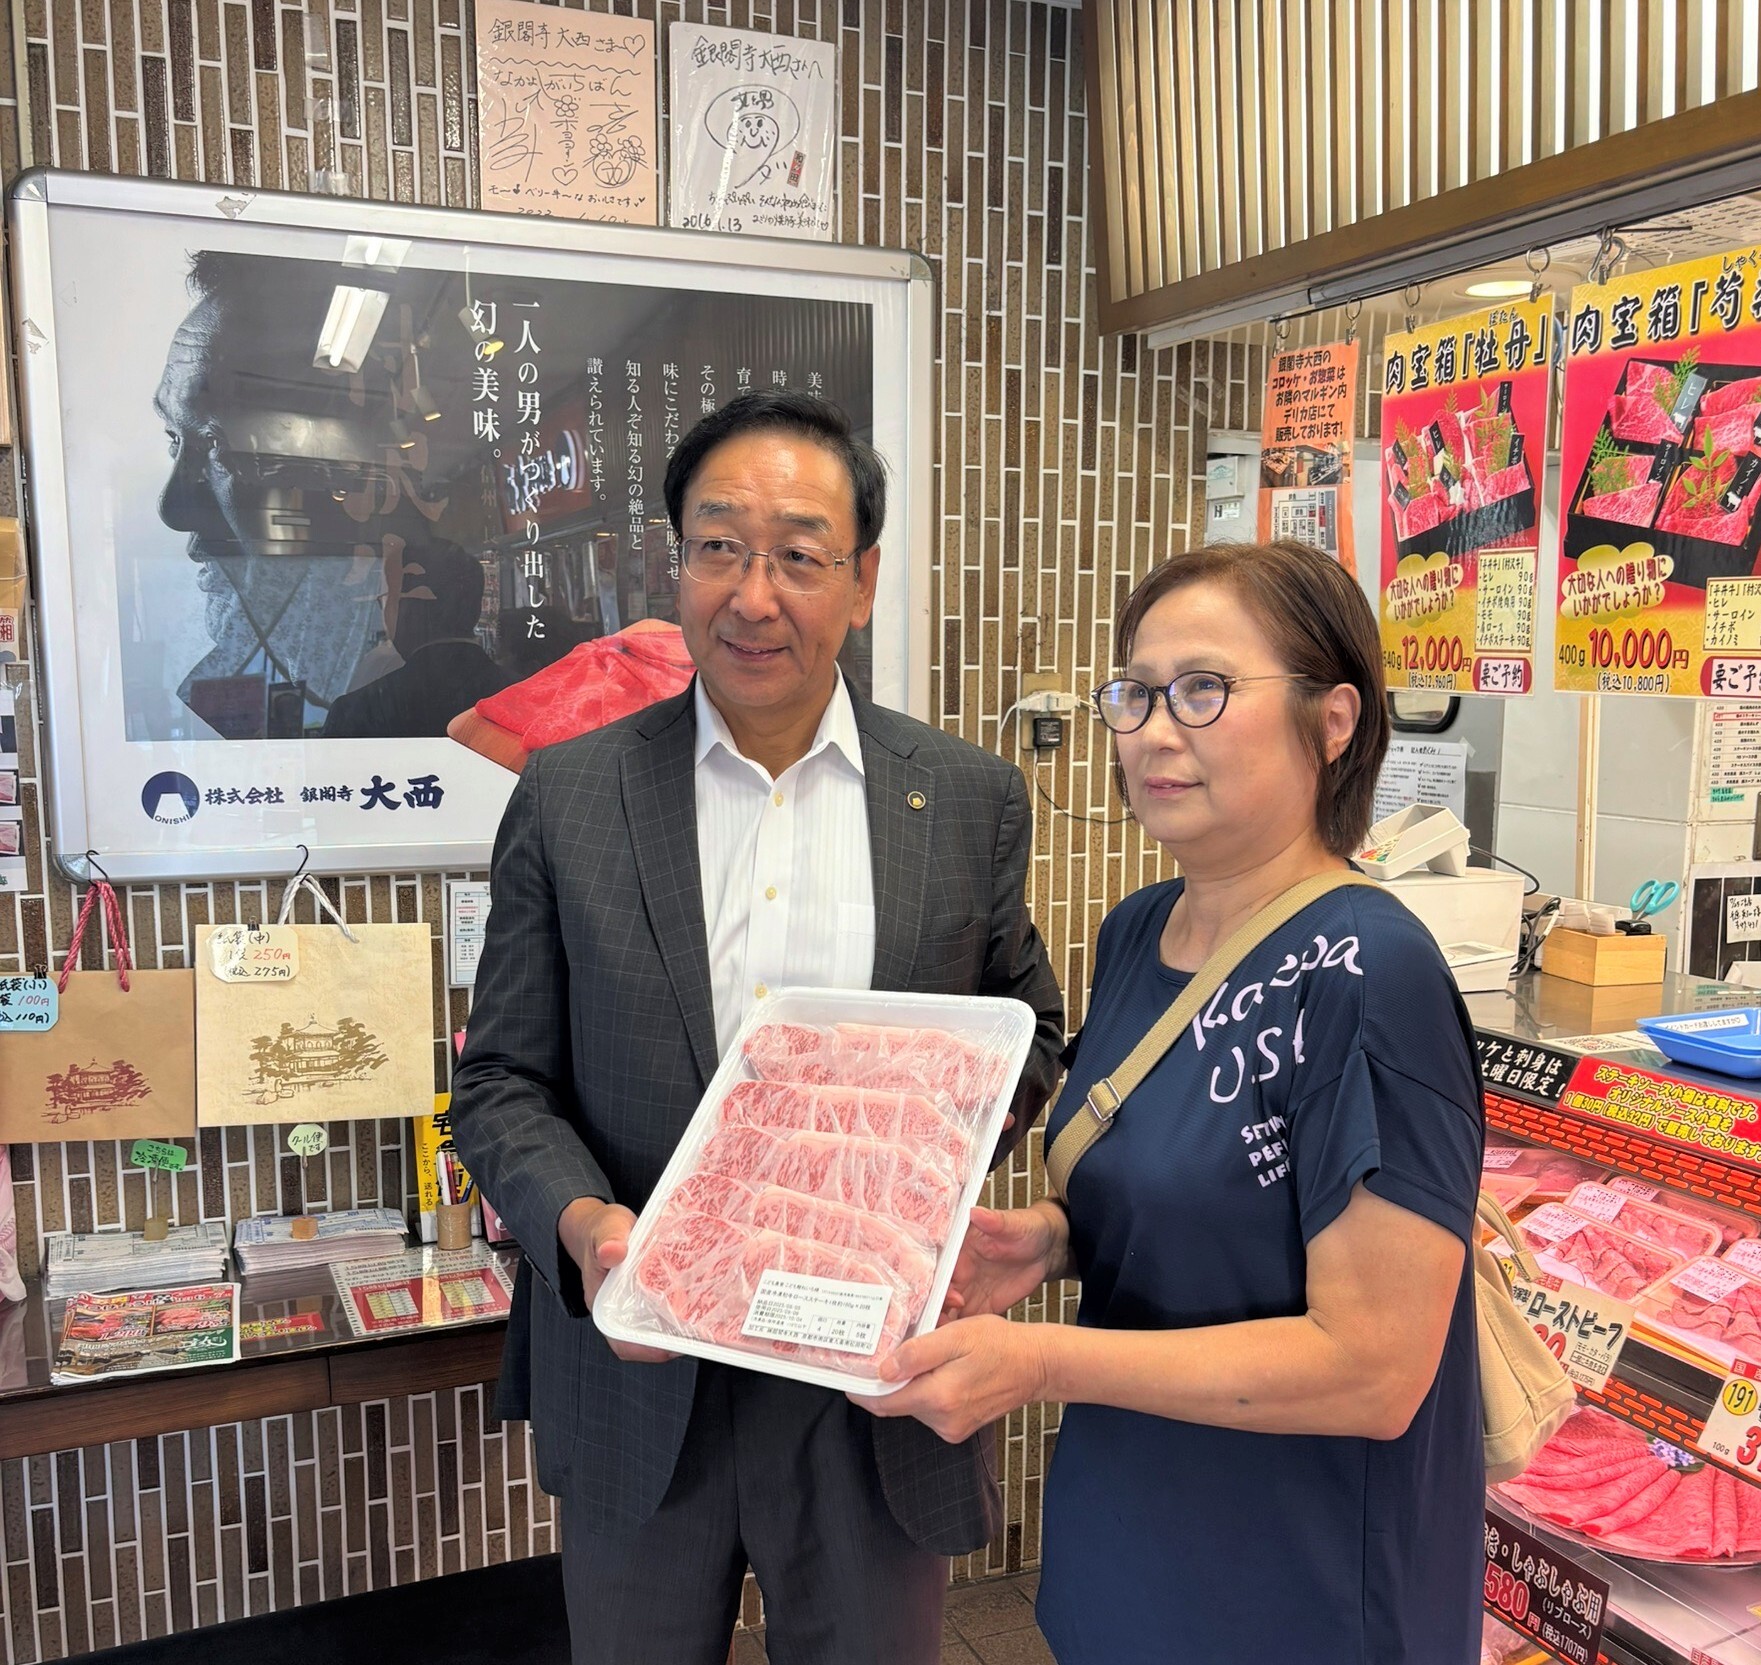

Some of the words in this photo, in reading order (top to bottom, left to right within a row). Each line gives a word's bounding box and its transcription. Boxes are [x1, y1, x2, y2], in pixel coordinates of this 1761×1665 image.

[556, 27, 591, 48] 大西
[1489, 307, 1519, 327] ぼたん
[1278, 350, 1331, 373] 銀閣寺大西の
[1385, 314, 1549, 395] 肉宝箱「牡丹」
[470, 299, 501, 458] 幻の美味。
[700, 365, 716, 414] その極
[1272, 365, 1346, 390] コロッケ・お惣菜は
[1276, 382, 1347, 407] お隣のマルギン内
[1284, 403, 1336, 424] デリカ店にて
[586, 357, 607, 501] 讃えられています。
[624, 360, 645, 551] 知る人ぞ知る幻の絶品と
[512, 302, 545, 640] 一人の男がつくり出した
[1567, 557, 1668, 596] 大切な人への贈り物に
[1558, 645, 1586, 667] 400g
[1480, 663, 1523, 689] 要ご予約
[205, 787, 285, 805] 株式会社
[359, 774, 445, 811] 大西
[154, 813, 190, 825] ONISHI
[253, 948, 291, 961] 250円
[1594, 1065, 1757, 1122] ステーキソース小袋は有料です。
[1608, 1086, 1734, 1132] オリジナルソース小袋を
[1527, 1290, 1623, 1351] ローストビーフ
[1727, 1383, 1754, 1412] 191
[1713, 1441, 1731, 1456] 100g
